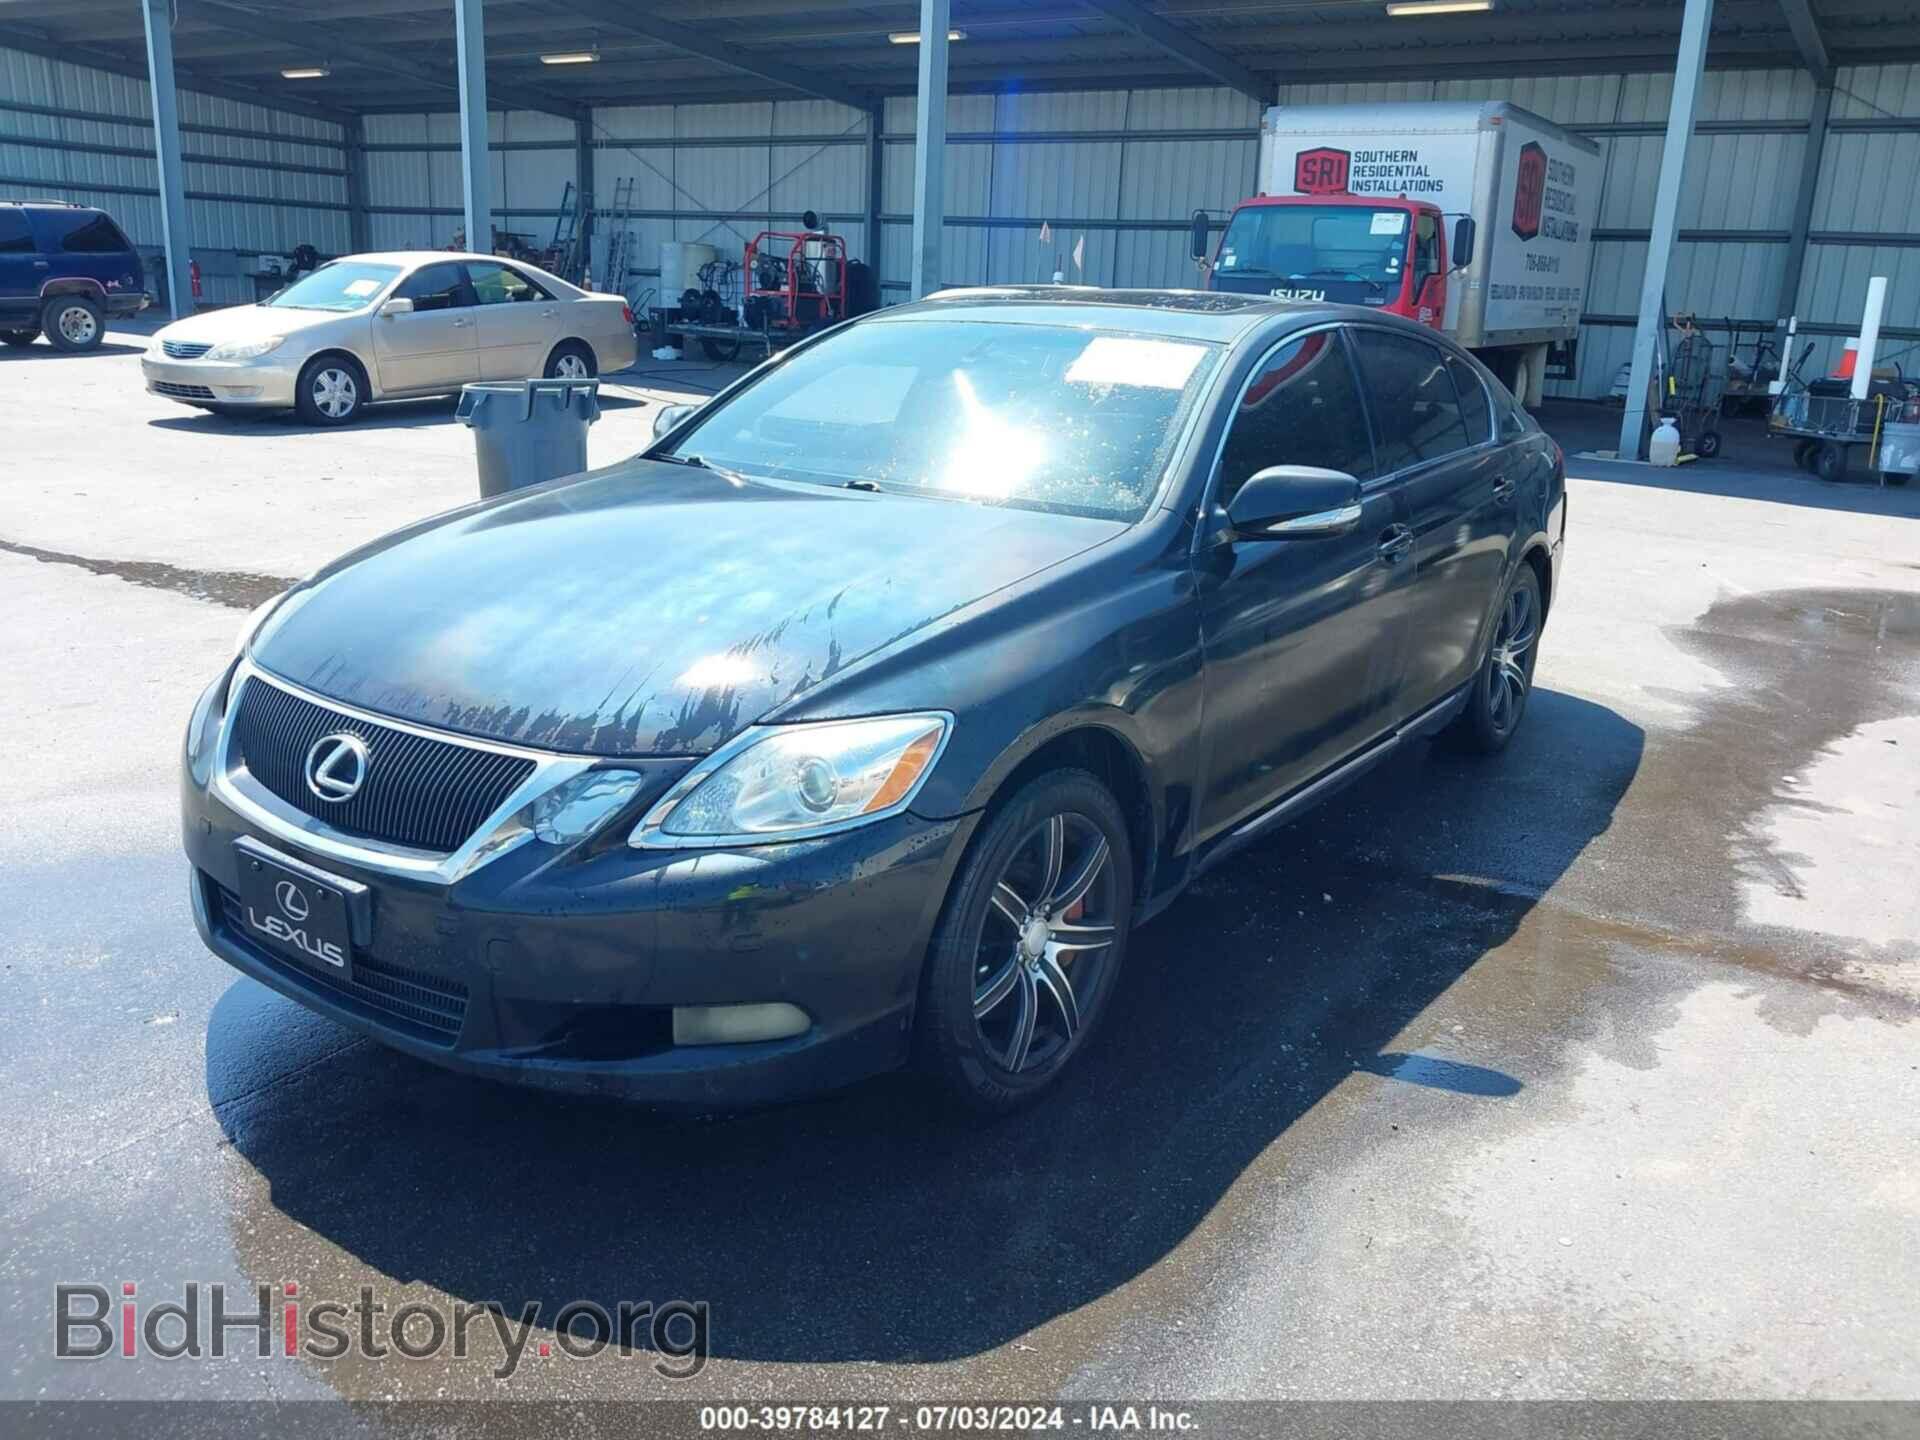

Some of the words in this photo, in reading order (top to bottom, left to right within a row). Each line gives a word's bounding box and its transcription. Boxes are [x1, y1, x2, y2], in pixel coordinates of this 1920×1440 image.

[1354, 150, 1418, 163] SOUTHERN
[1302, 157, 1342, 187] SRI
[1353, 165, 1430, 178] RESIDENTIAL
[1352, 180, 1444, 192] INSTALLATIONS
[1270, 288, 1325, 302] ISUZU
[248, 906, 345, 968] LEXUS
